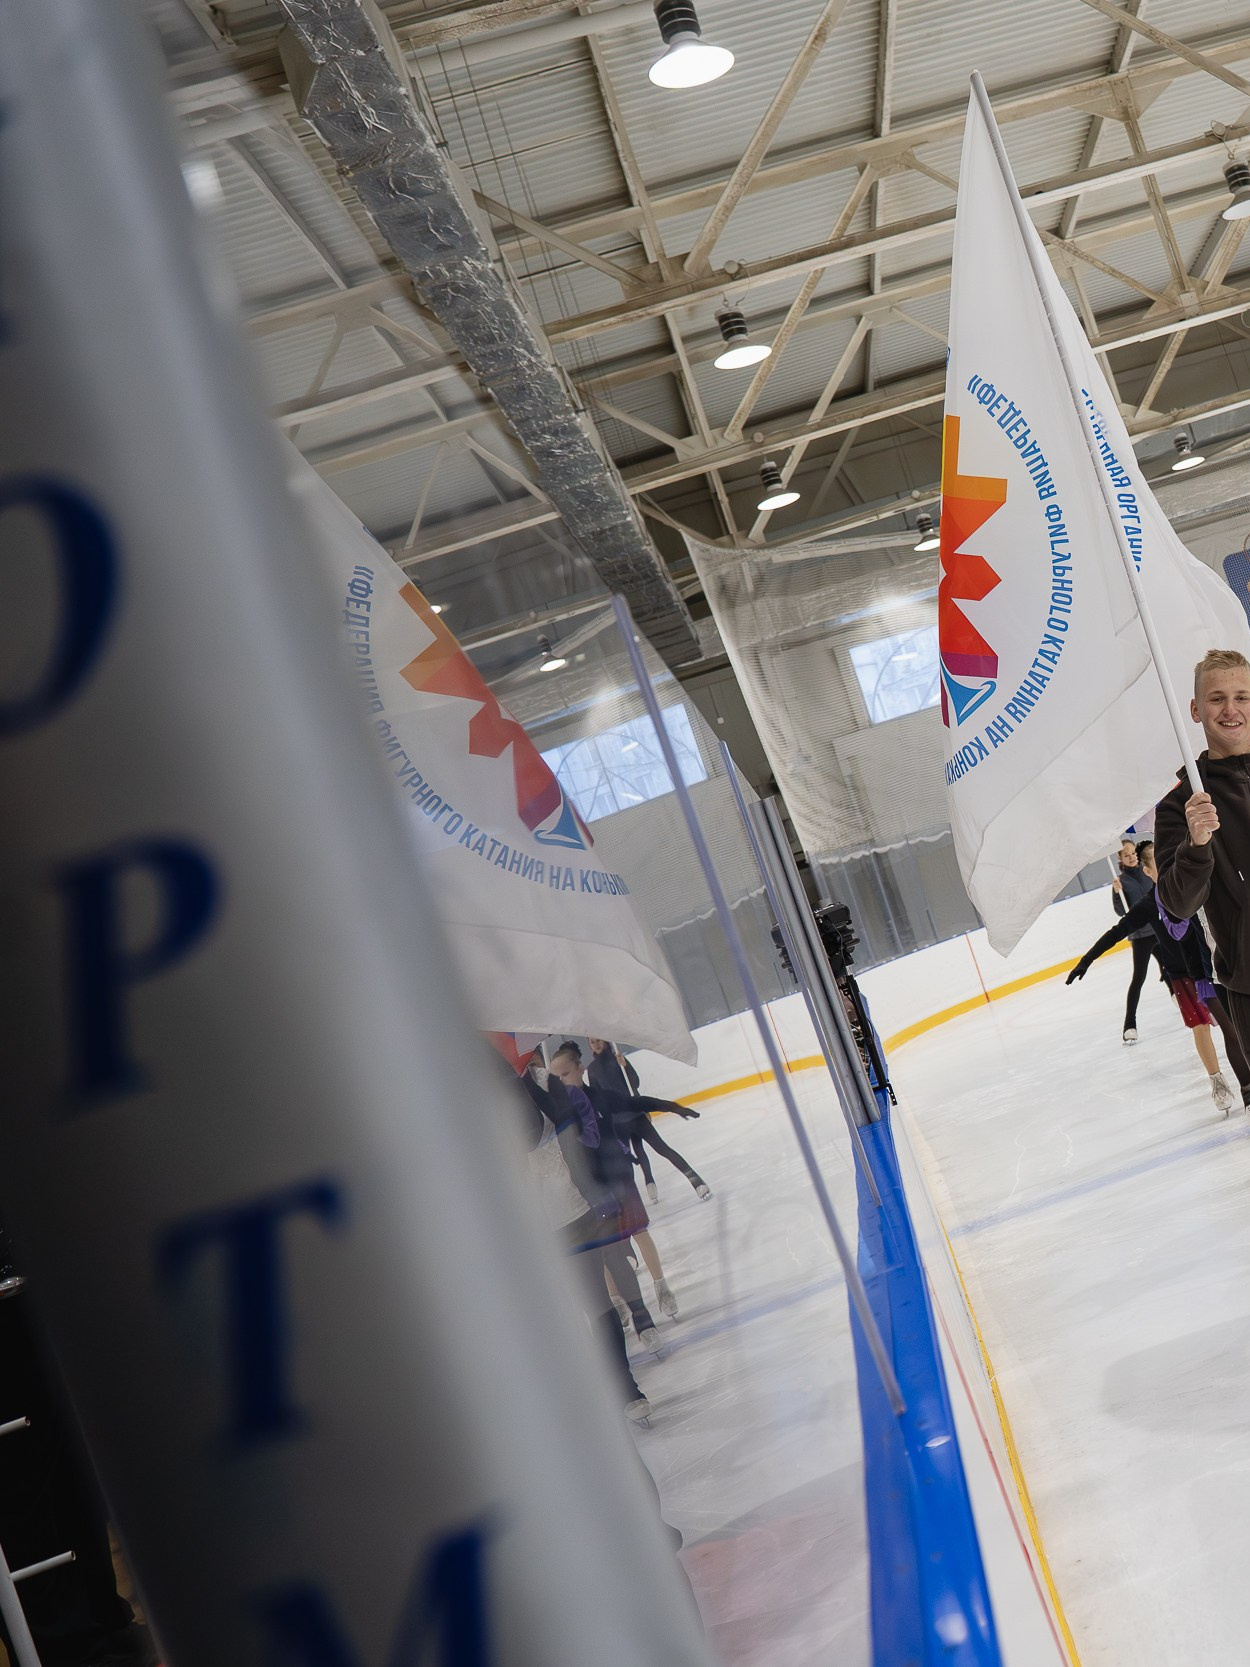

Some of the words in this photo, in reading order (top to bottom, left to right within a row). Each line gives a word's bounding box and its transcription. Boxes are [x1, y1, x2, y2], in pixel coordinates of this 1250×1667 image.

[1117, 493, 1143, 573] ОРГАНИ
[457, 823, 545, 884] КАТАНИЯ
[549, 865, 575, 891] НА
